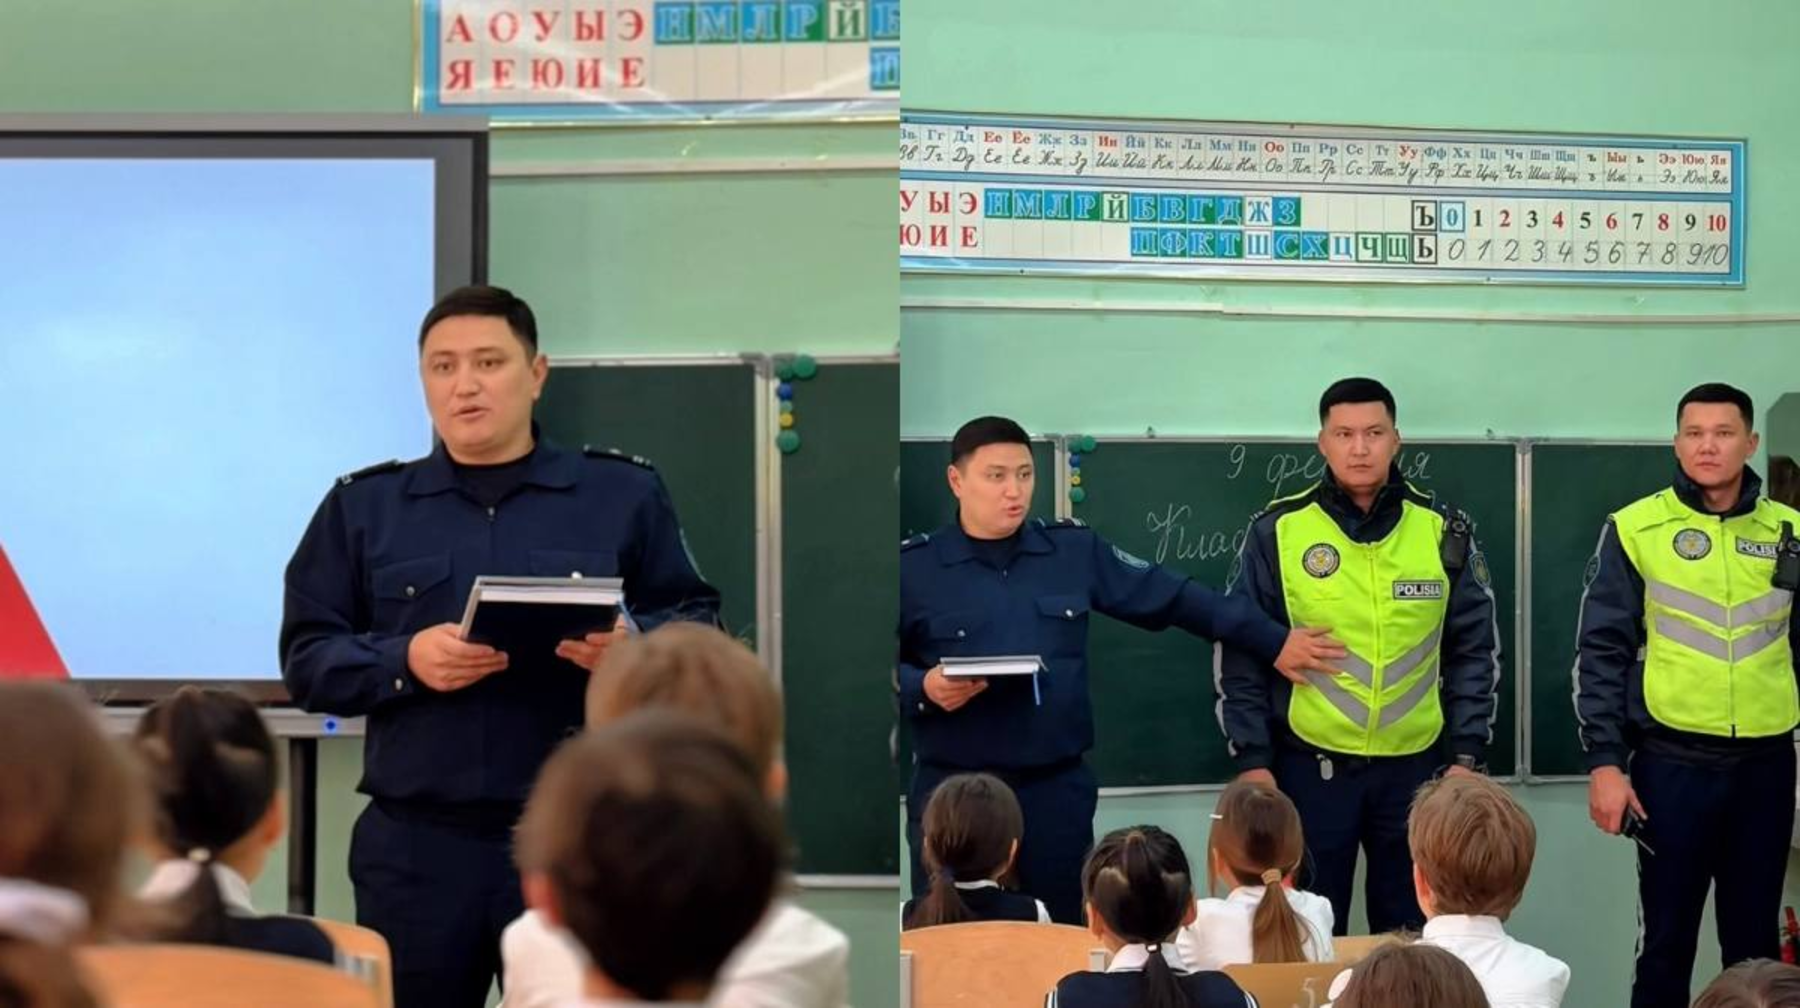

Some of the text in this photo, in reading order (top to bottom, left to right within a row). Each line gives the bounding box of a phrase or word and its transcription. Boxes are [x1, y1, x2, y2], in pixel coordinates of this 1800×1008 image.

[445, 12, 474, 42] А
[488, 11, 519, 40] О
[530, 11, 560, 40] У
[574, 11, 605, 40] Ы
[617, 11, 644, 41] Э
[656, 5, 691, 40] Н
[699, 5, 738, 38] М
[745, 5, 777, 38] Л
[789, 4, 818, 38] Р
[836, 3, 861, 36] Й
[445, 59, 473, 90] Я
[531, 58, 564, 89] Ю
[576, 58, 601, 89] И
[621, 57, 644, 89] Е
[929, 192, 949, 214] Ы
[959, 192, 977, 215] Э
[987, 192, 1010, 216] Н
[1014, 193, 1042, 217] М
[1046, 194, 1069, 218] Л
[1076, 195, 1096, 218] Р
[1108, 193, 1125, 219] Й
[1134, 196, 1156, 220] Б
[1163, 197, 1185, 221] В
[1192, 198, 1213, 222] Г
[1218, 198, 1241, 225] Д
[1248, 201, 1270, 222] Ж
[1278, 200, 1296, 224] З
[1416, 206, 1434, 227] Ъ
[1447, 209, 1727, 231] 0 1 2 3 4 5 6 7 8 9 10
[929, 226, 947, 247] И
[961, 226, 978, 248] Е
[1133, 229, 1157, 254] П
[1161, 231, 1186, 255] Ф
[1191, 231, 1214, 256] К
[1220, 232, 1241, 256] Т
[1248, 235, 1269, 255] Ш
[1276, 234, 1299, 258] С
[1302, 234, 1328, 258] Х
[1334, 236, 1352, 258] Ц
[1361, 237, 1379, 257] Ч
[1388, 237, 1408, 260] Щ
[1418, 238, 1433, 259] Ь
[1449, 239, 1465, 260] 0
[1478, 239, 1492, 261] 1
[1504, 239, 1519, 261] 2
[1532, 240, 1545, 262] 3
[1559, 241, 1571, 263] 4
[1584, 241, 1599, 264] 5
[1608, 242, 1624, 264] 6
[1635, 242, 1651, 264] 7
[1661, 242, 1676, 265] 8
[1227, 444, 1246, 479] 9
[1739, 540, 1779, 556] POLISI
[1396, 584, 1441, 597] POLISIA
